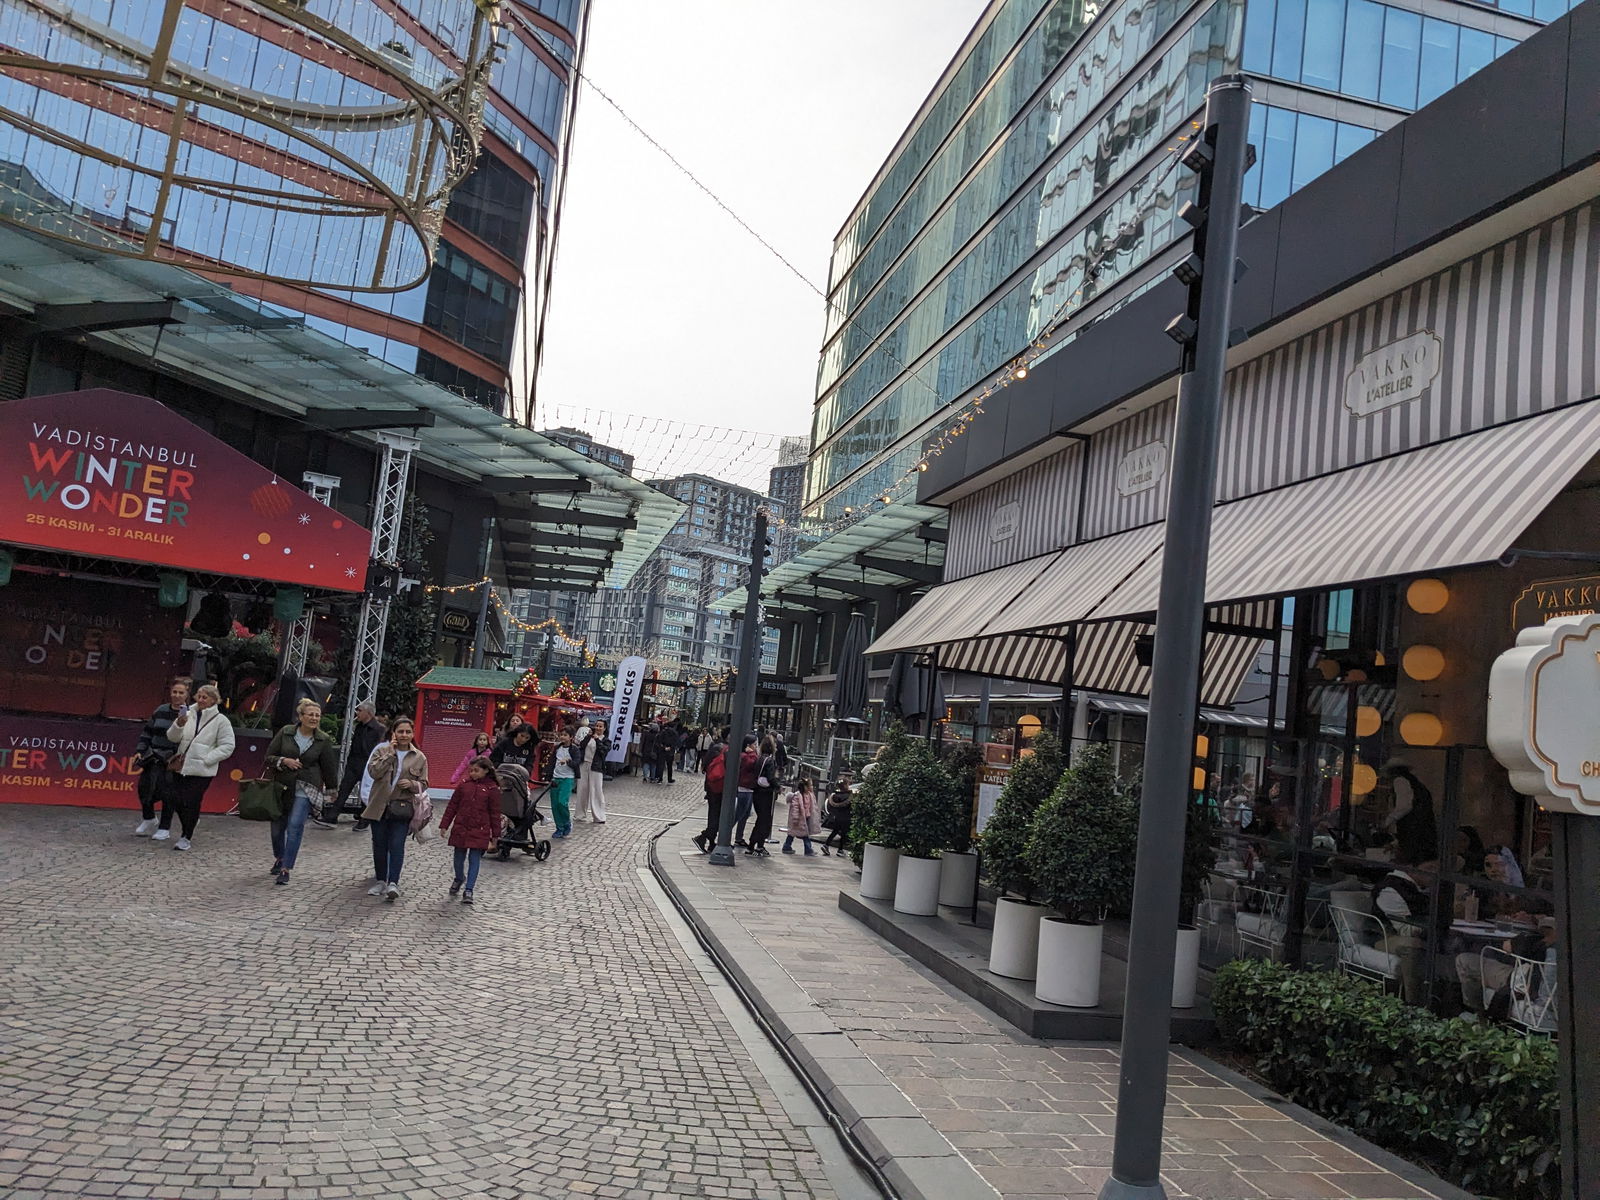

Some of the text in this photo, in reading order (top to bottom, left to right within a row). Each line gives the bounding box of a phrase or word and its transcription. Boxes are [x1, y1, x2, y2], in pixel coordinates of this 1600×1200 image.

[1361, 345, 1426, 384] VAKKO
[1366, 375, 1412, 404] L'ATELIER
[29, 442, 194, 500] WINTER
[23, 475, 189, 528] WONDER
[26, 513, 46, 525] 25
[49, 516, 95, 533] KASIM
[107, 526, 121, 537] 31
[124, 531, 174, 545] ARALIK
[612, 670, 637, 751] STARBUCKS
[2, 775, 51, 787] KASIM
[81, 779, 134, 791] ARALIK
